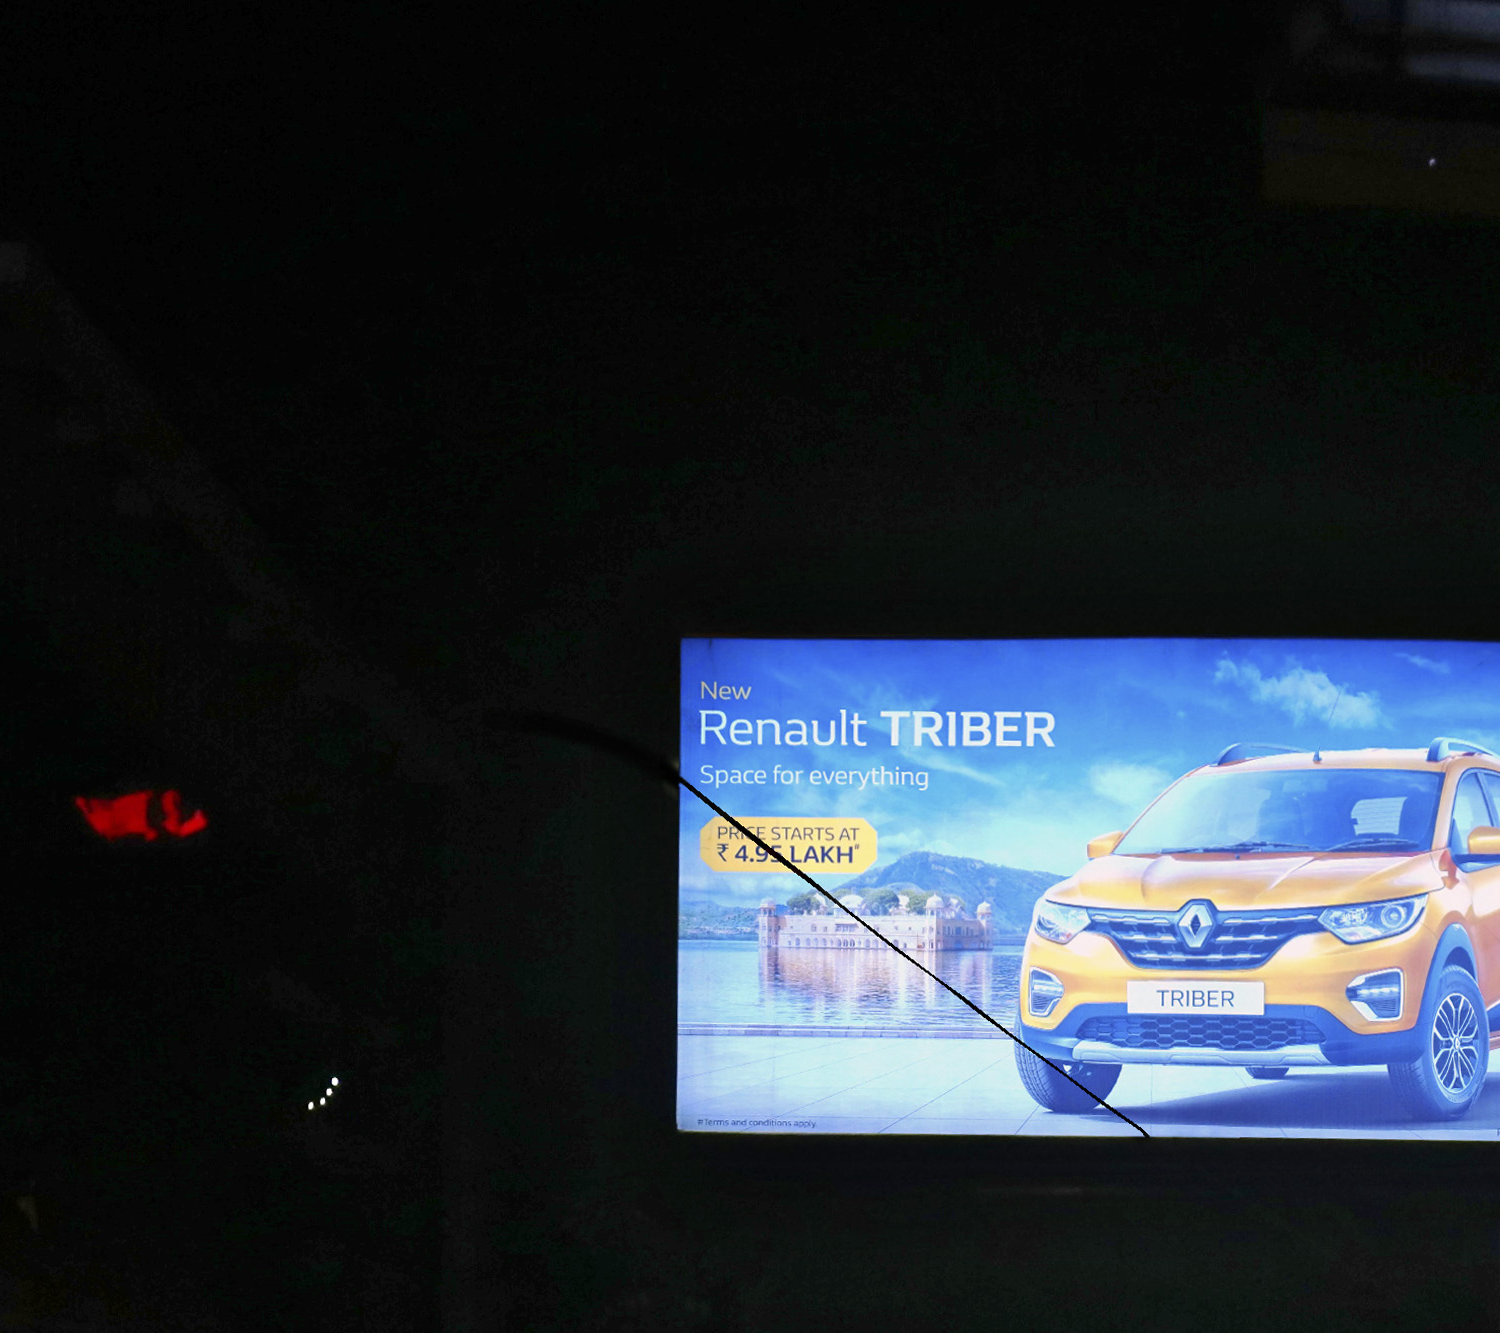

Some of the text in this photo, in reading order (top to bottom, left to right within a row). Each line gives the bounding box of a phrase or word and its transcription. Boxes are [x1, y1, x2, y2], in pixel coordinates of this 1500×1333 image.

[700, 681, 752, 700] New
[699, 709, 1056, 748] Renault TRIBER
[700, 765, 930, 791] Space for everything
[771, 826, 835, 841] STARTS
[839, 827, 860, 841] AT
[1156, 989, 1235, 1008] TRIBER
[730, 1119, 747, 1127] and
[748, 1119, 792, 1127] conditions
